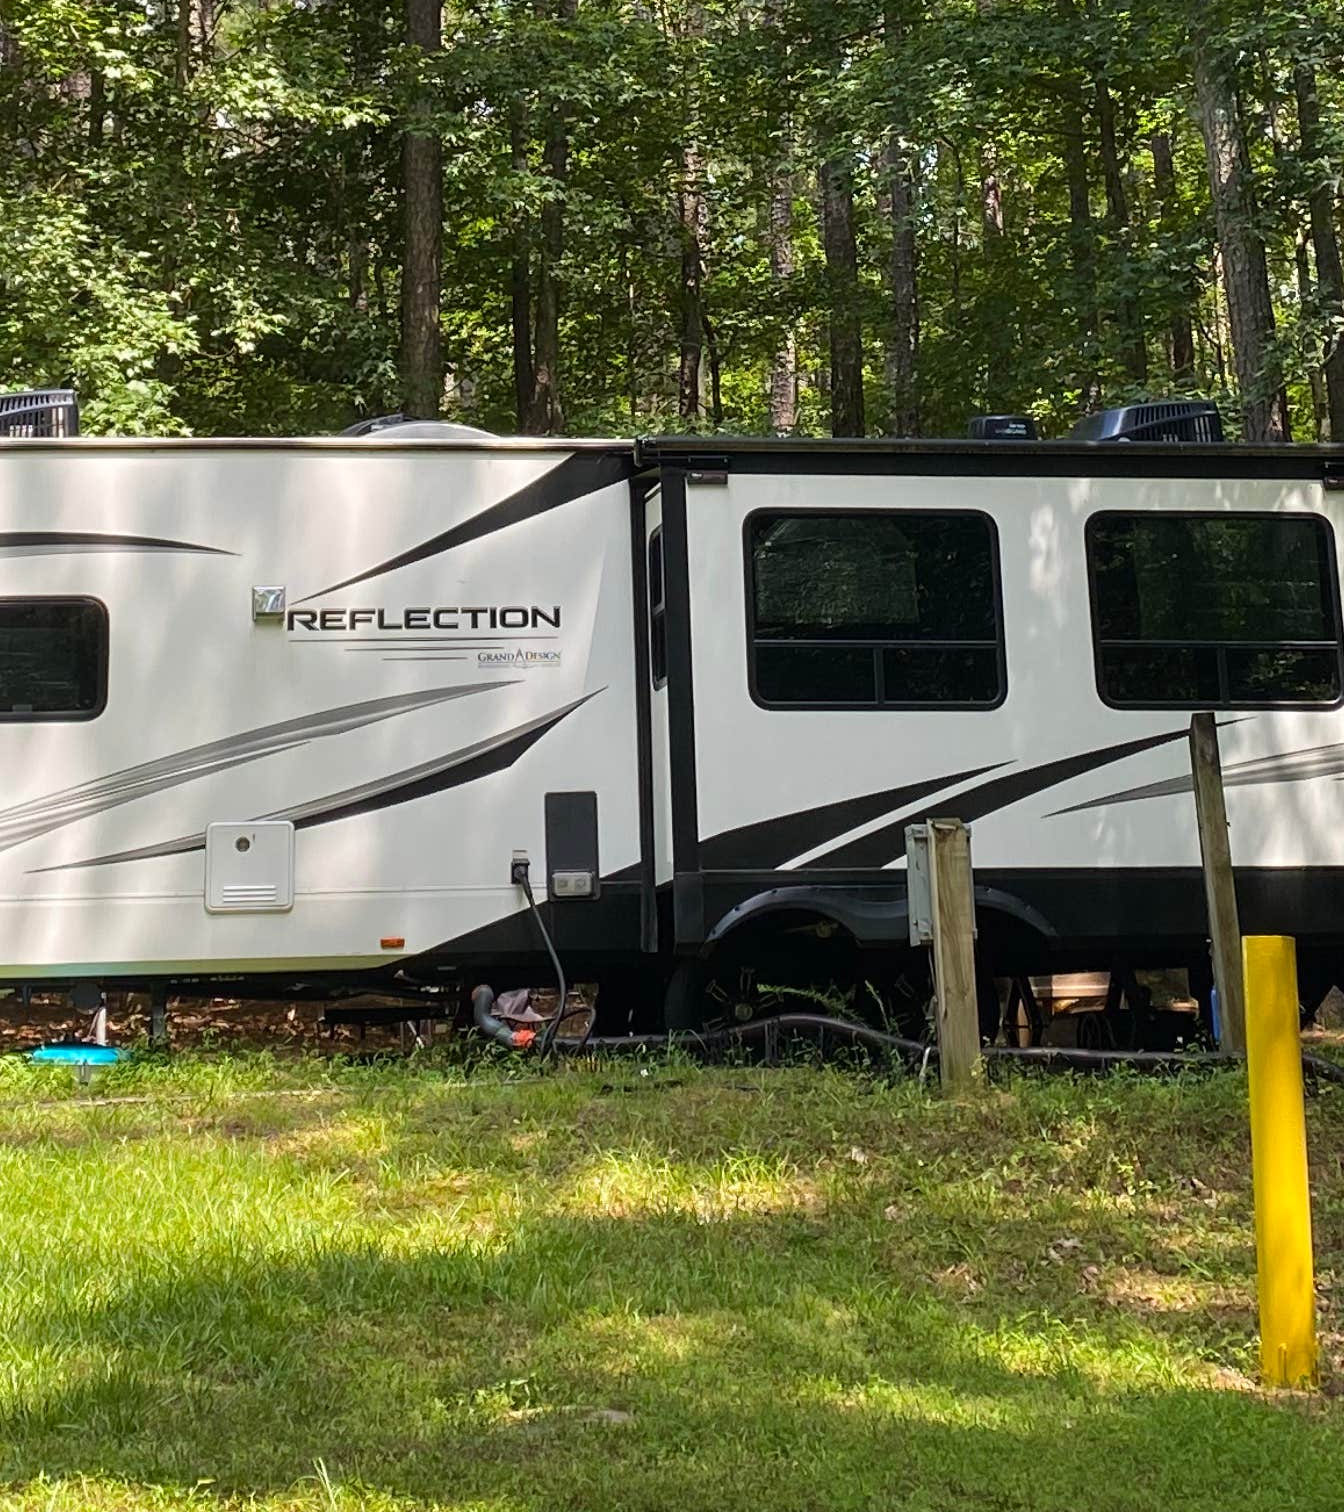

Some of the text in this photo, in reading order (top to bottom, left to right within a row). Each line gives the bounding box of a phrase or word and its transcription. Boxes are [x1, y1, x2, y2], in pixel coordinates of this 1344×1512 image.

[287, 606, 560, 630] REFLECTION
[478, 651, 560, 662] GRAND DESIGN
